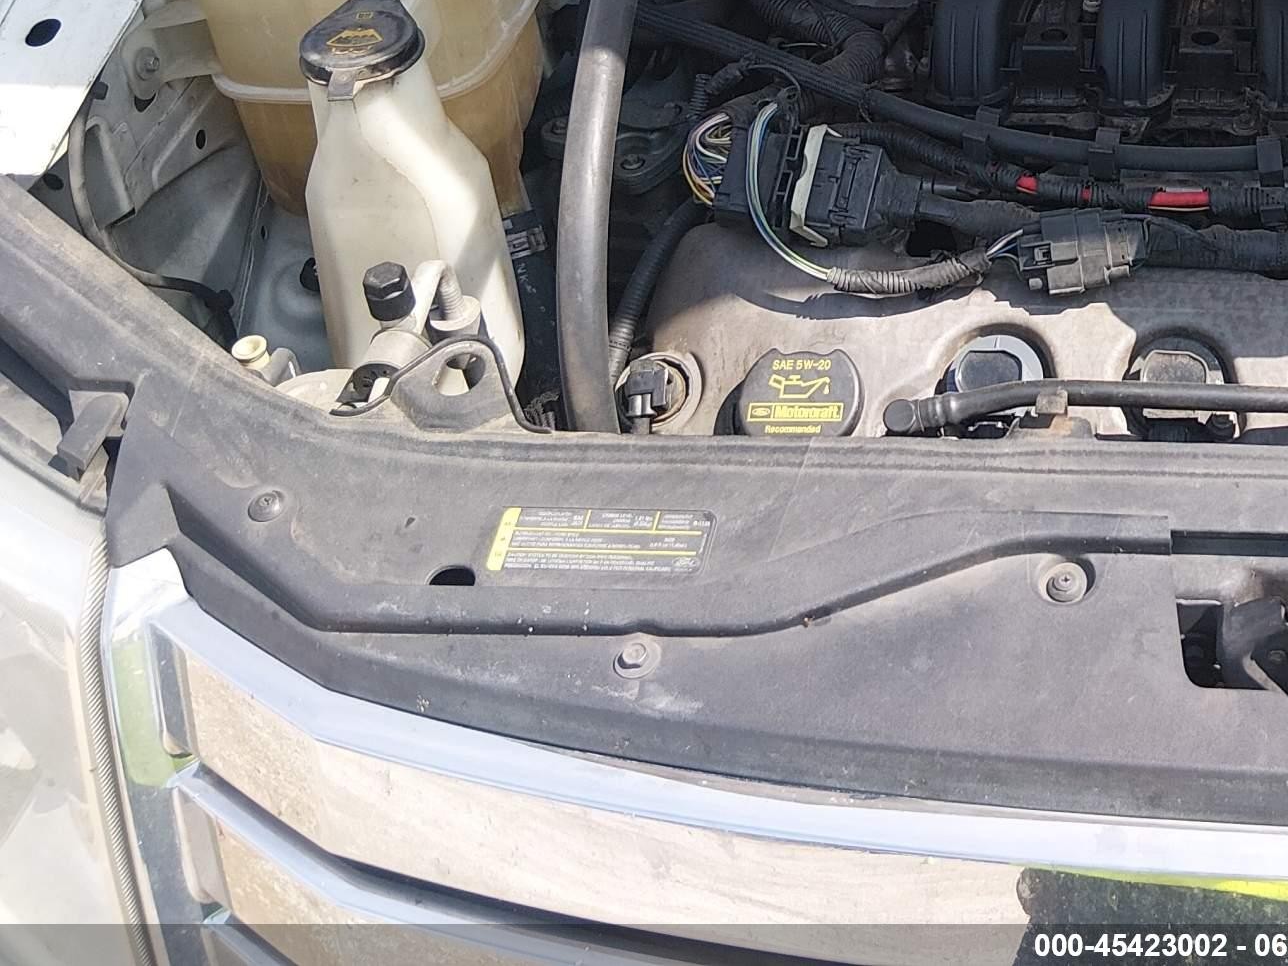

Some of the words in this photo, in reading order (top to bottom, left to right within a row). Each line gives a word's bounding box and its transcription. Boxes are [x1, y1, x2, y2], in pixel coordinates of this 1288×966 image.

[772, 359, 794, 371] SAE
[796, 359, 832, 371] 5W-20
[774, 405, 840, 419] Motorcraft
[764, 424, 822, 434] Recommended
